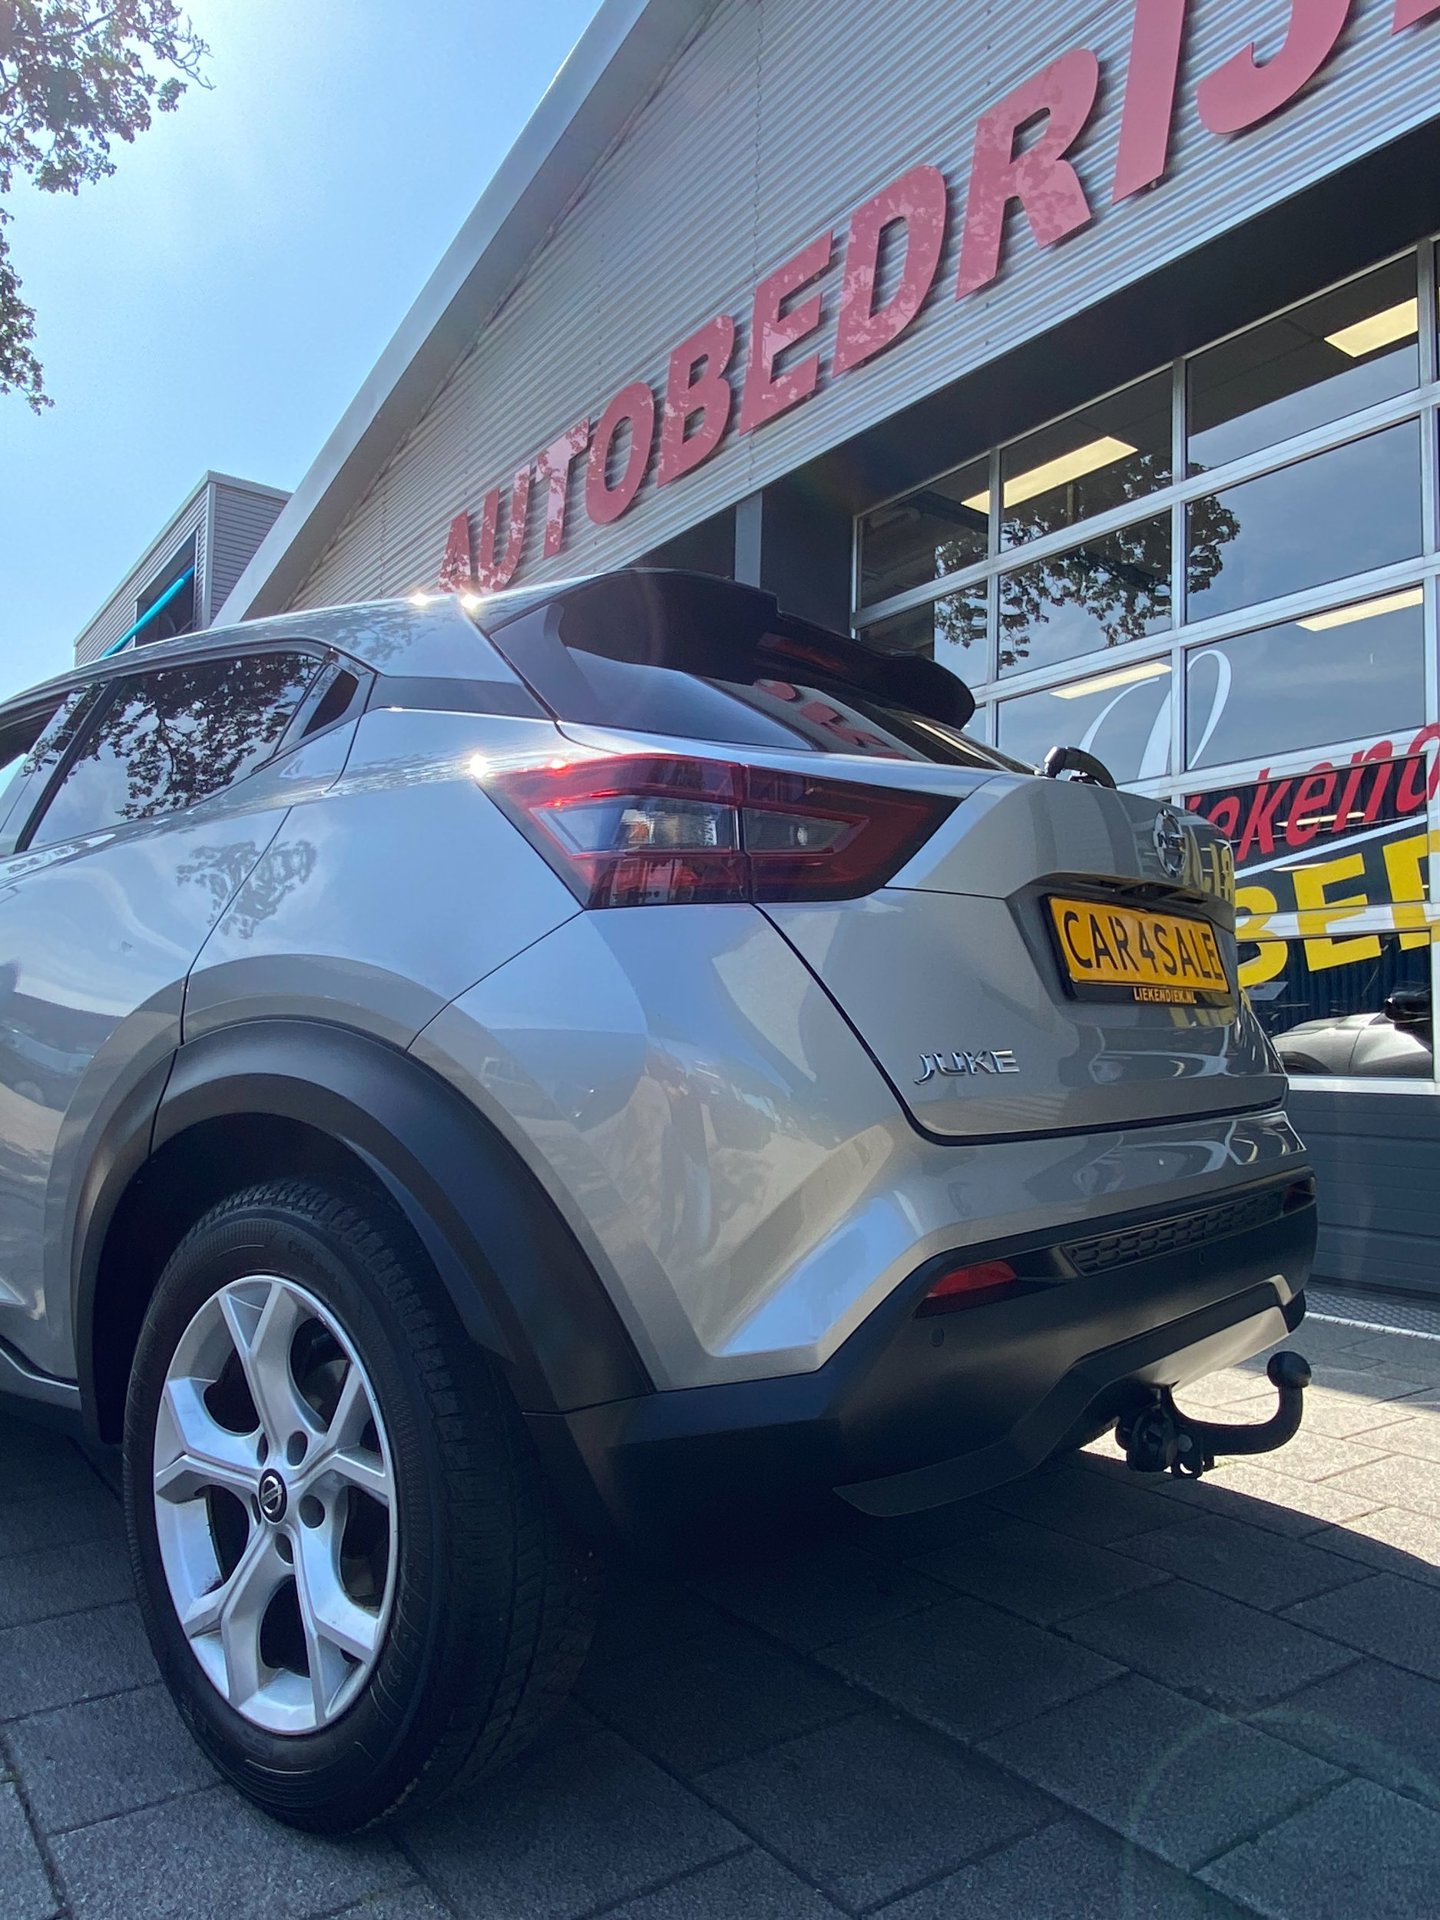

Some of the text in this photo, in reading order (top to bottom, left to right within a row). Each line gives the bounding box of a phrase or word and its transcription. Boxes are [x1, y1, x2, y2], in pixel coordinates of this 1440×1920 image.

[438, 0, 1440, 594] AUTOBEDRIJ
[1063, 910, 1224, 982] CAR4SALE
[913, 1049, 1020, 1086] JUKE
